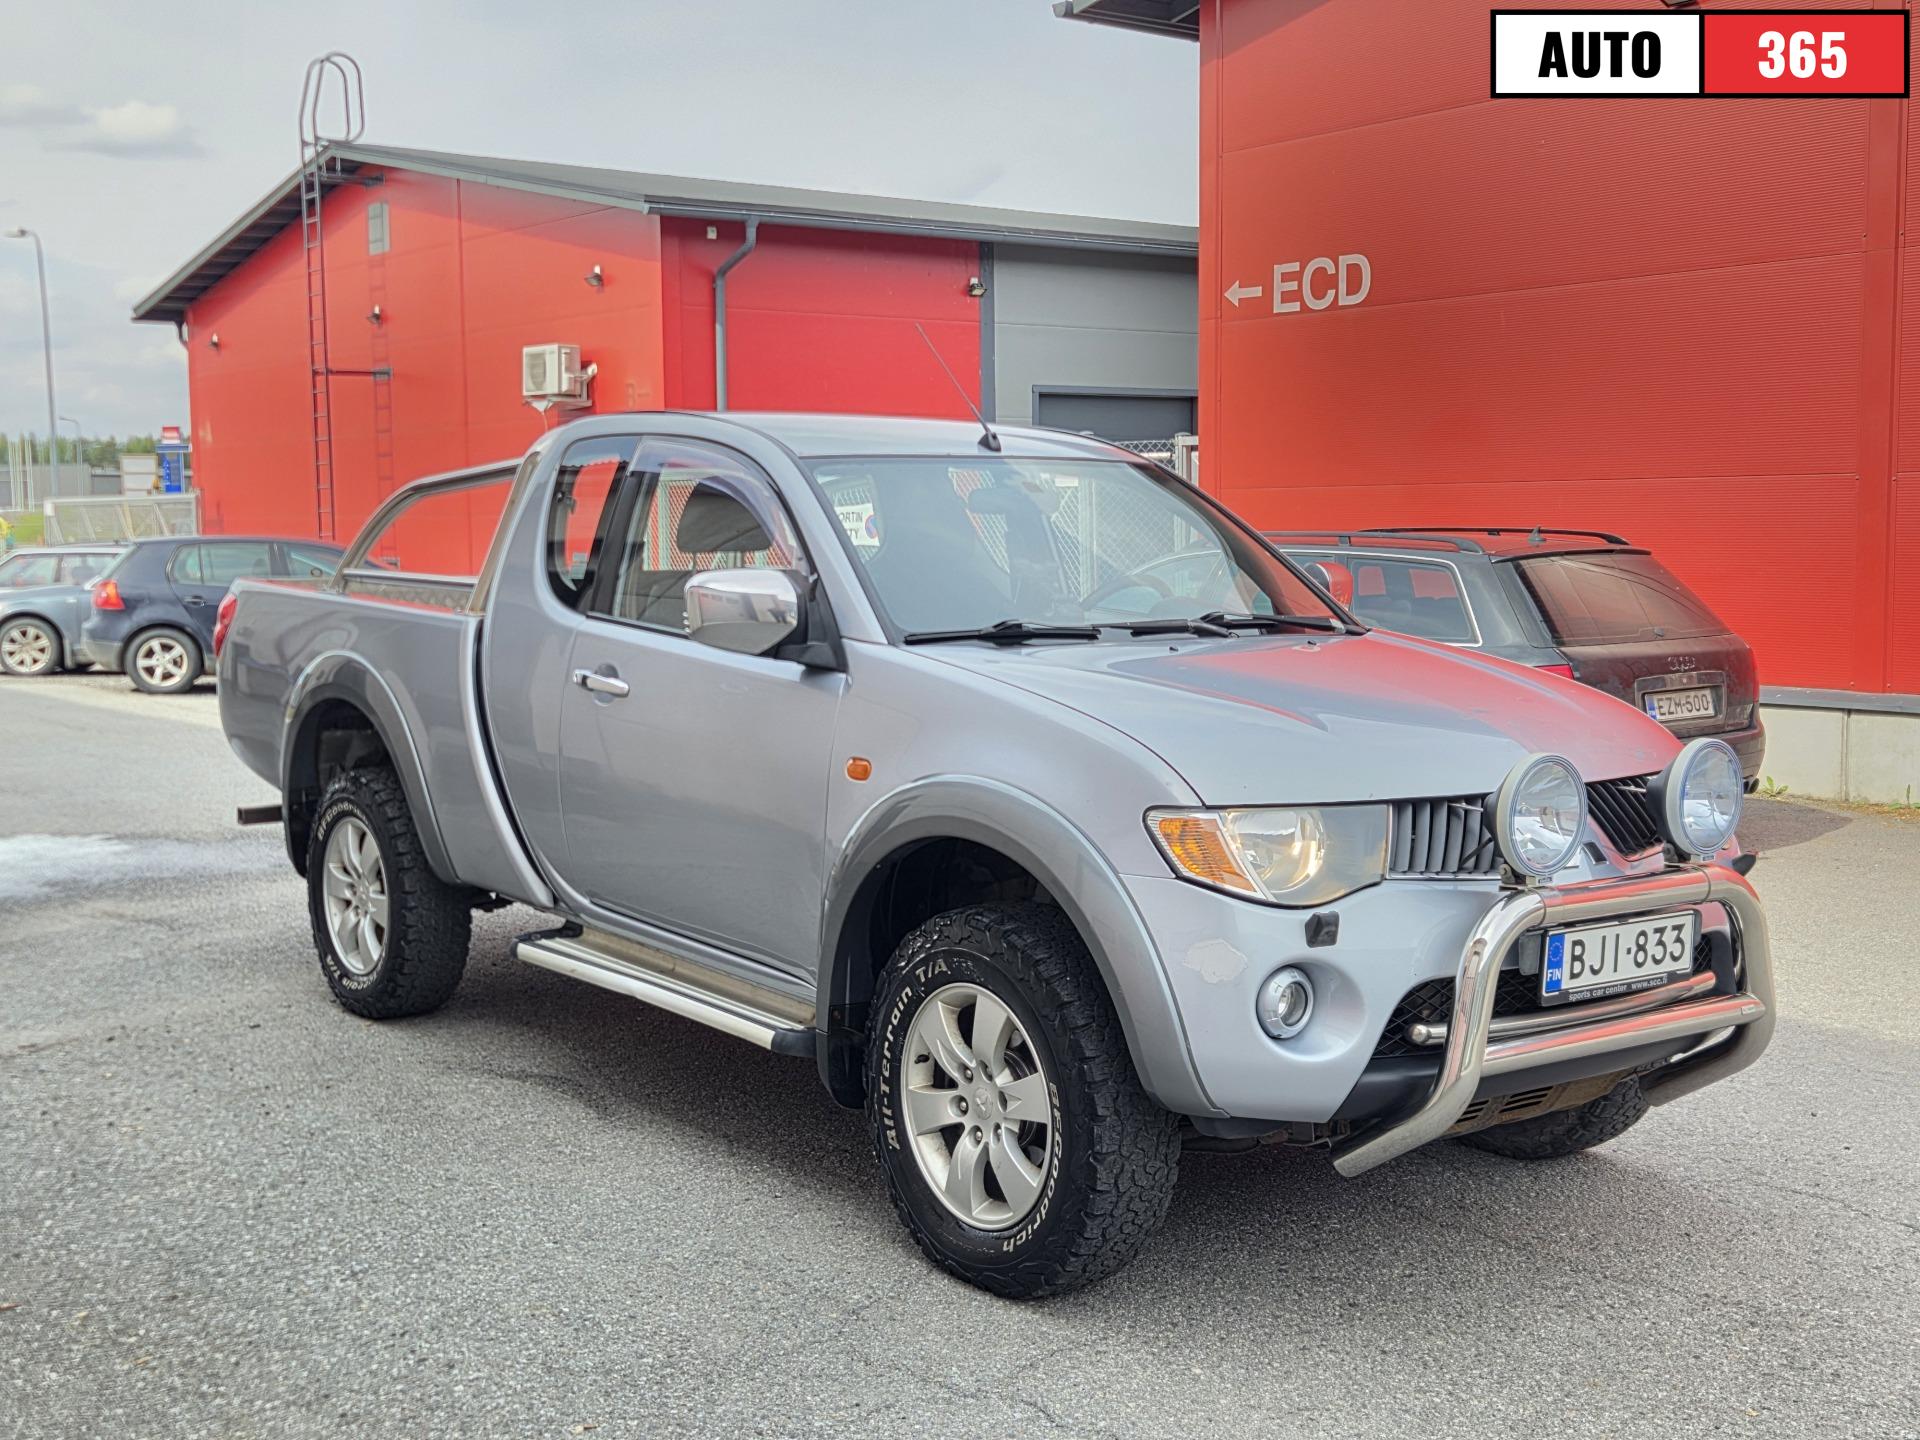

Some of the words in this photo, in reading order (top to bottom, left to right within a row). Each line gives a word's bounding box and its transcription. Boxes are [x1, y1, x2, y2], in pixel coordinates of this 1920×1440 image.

[1273, 253, 1371, 314] ECD
[1656, 693, 1710, 716] EZM-500
[1547, 969, 1562, 982] FIN
[1569, 923, 1686, 980] BJI-833
[1569, 990, 1591, 1003] sports
[1592, 988, 1605, 998] car
[1605, 984, 1628, 995] center
[1631, 975, 1669, 991] www.scc.fi
[880, 985, 913, 1151] All-Terrain
[915, 958, 949, 984] T/A
[1002, 1082, 1063, 1252] BFGoodrich
